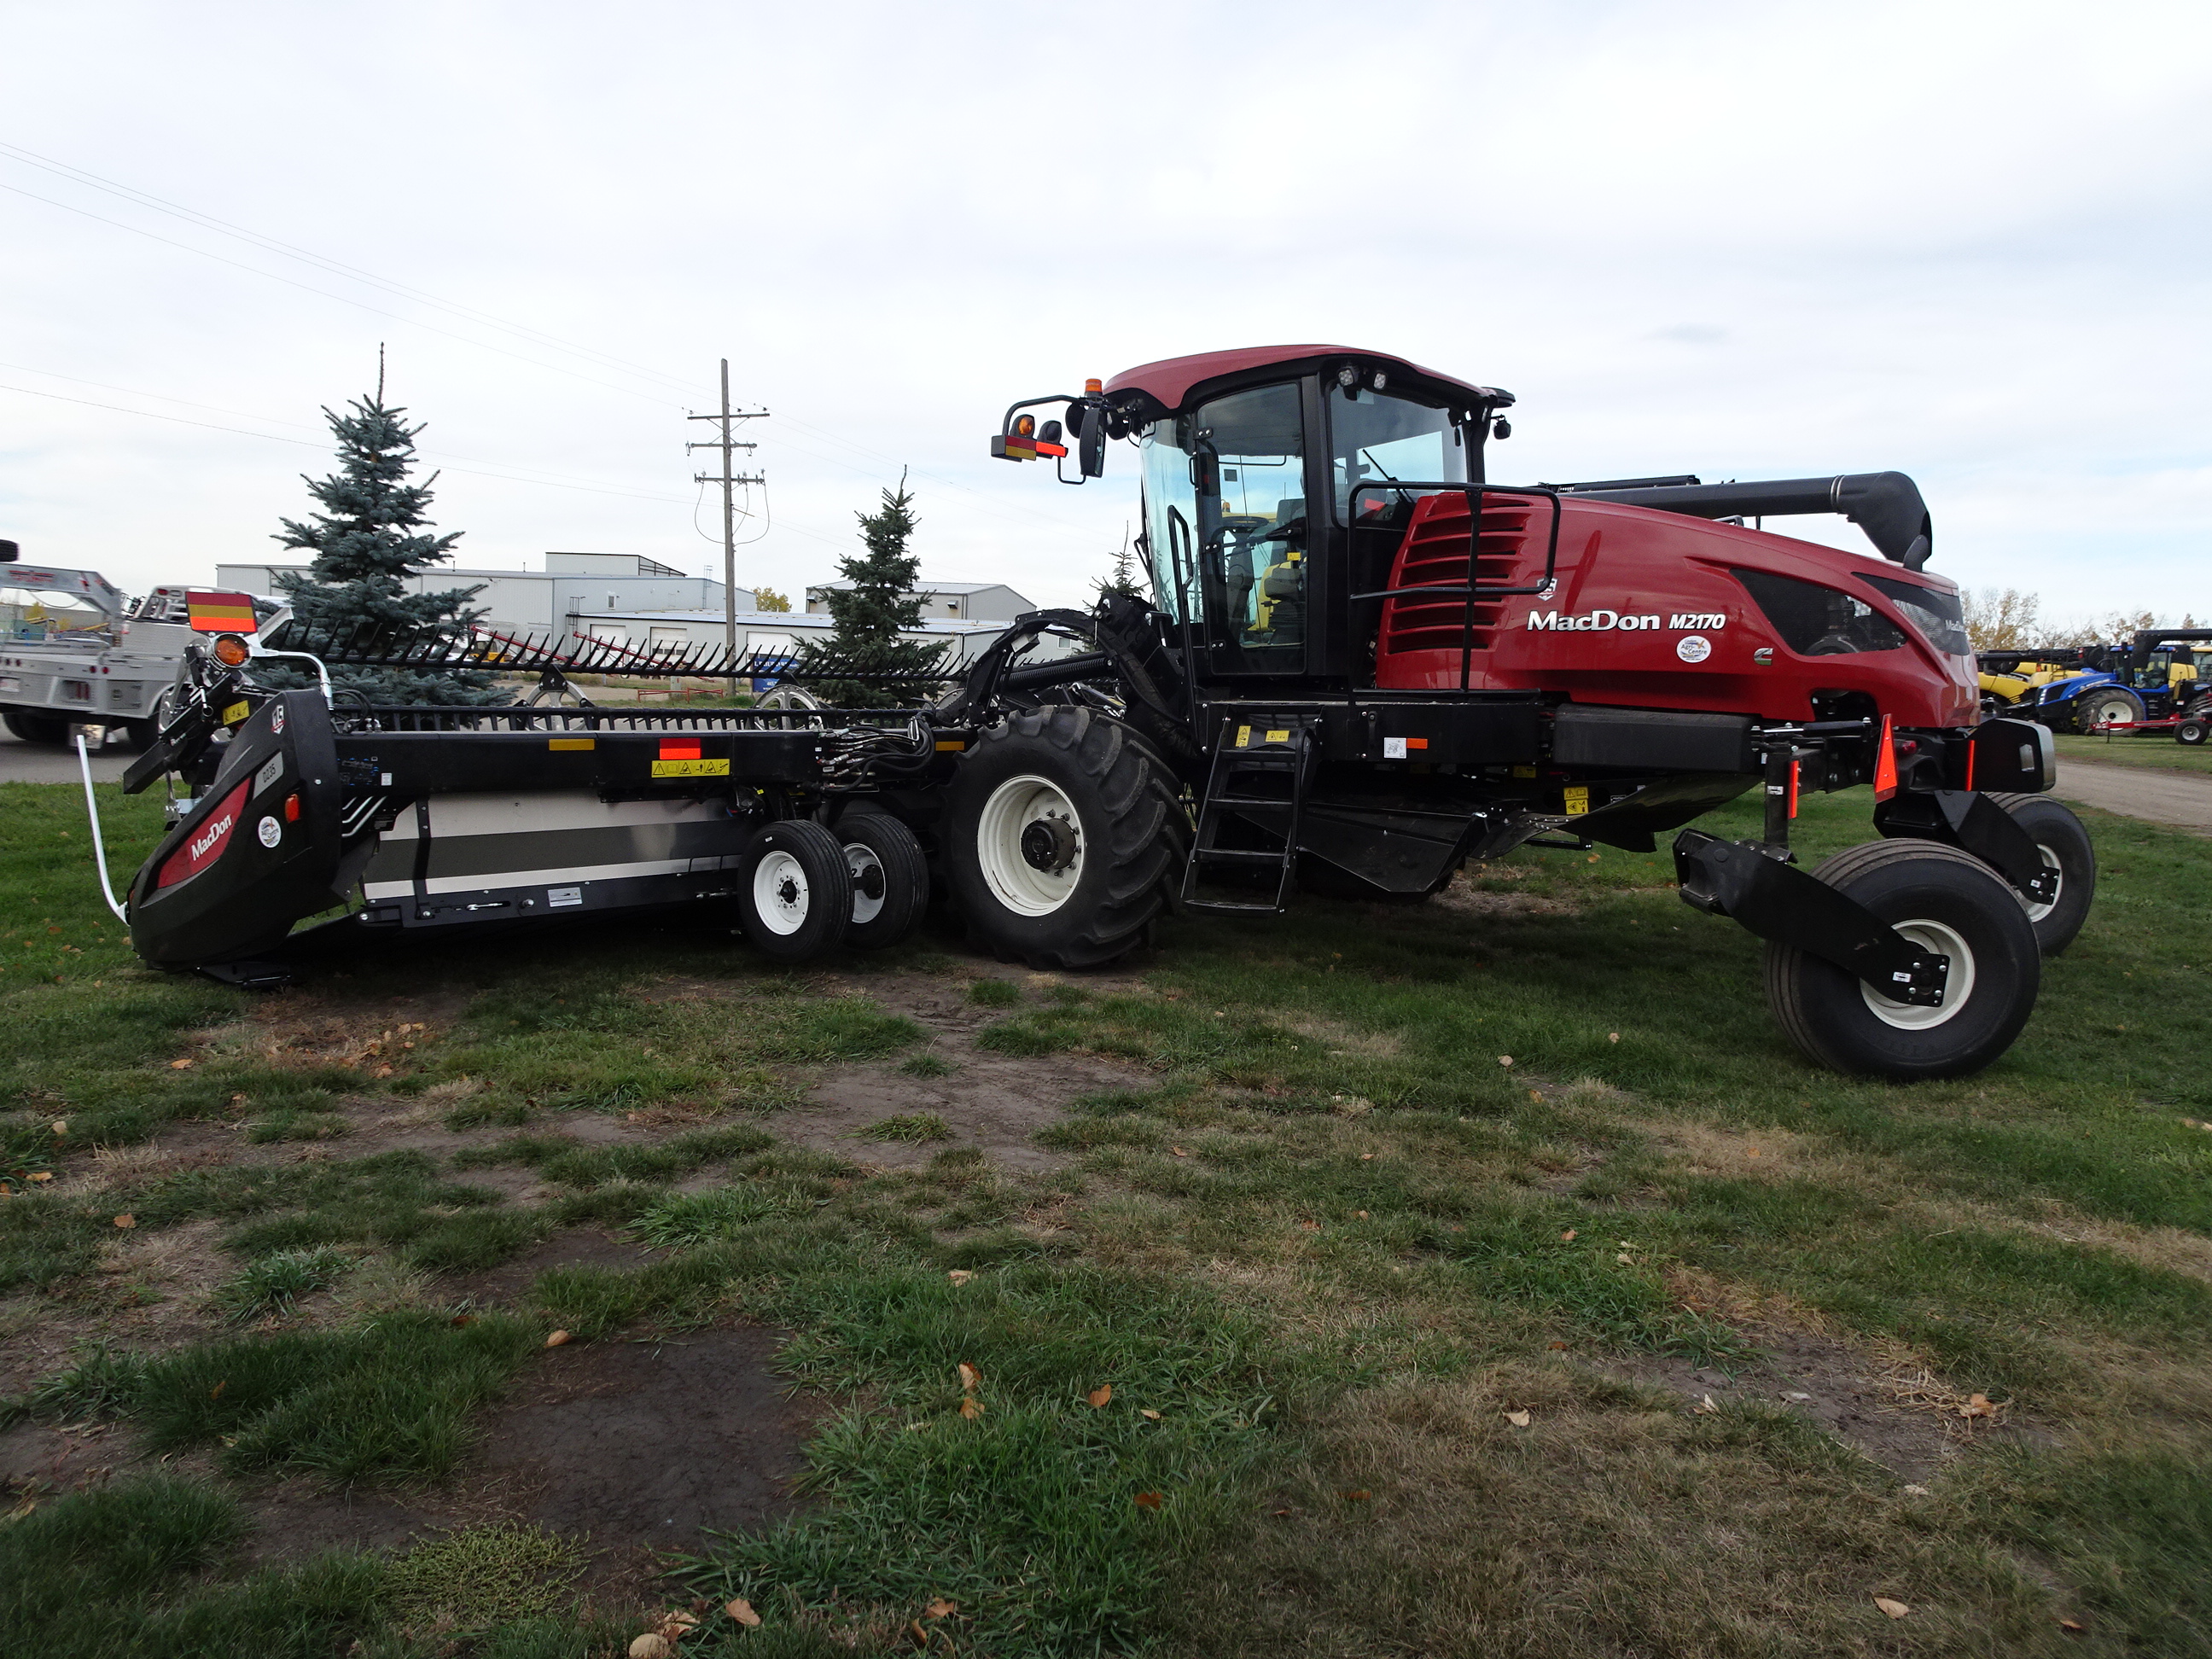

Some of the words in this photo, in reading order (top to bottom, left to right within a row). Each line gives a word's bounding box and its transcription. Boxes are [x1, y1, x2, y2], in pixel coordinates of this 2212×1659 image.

[1527, 610, 1660, 631] MacDon
[1668, 613, 1726, 630] M2170
[263, 765, 276, 783] D235
[191, 814, 231, 860] MacDon
